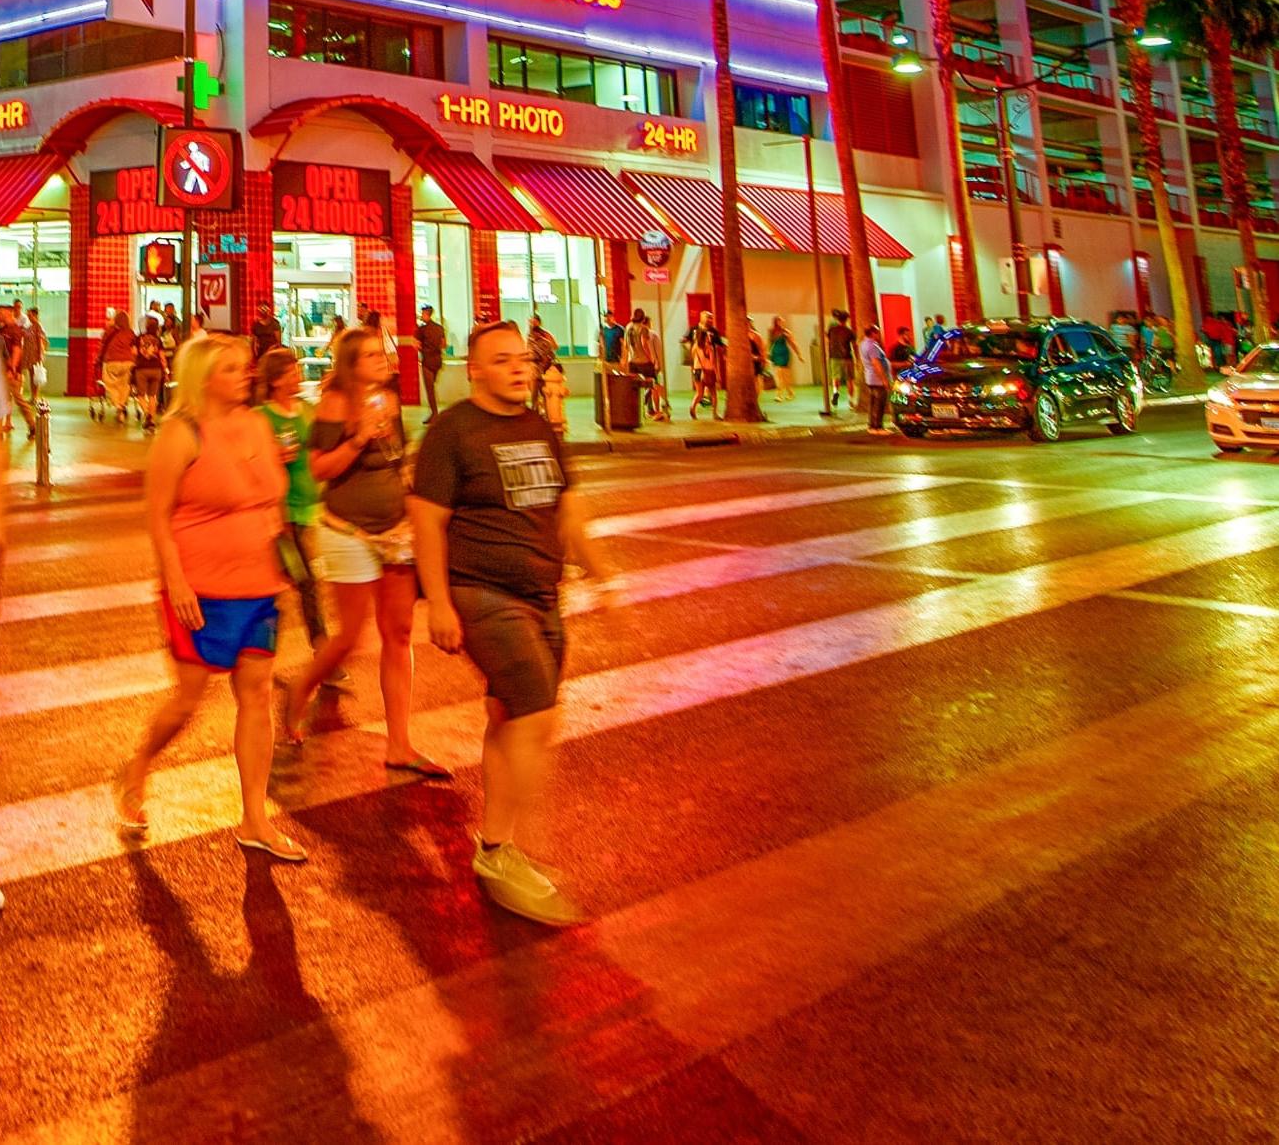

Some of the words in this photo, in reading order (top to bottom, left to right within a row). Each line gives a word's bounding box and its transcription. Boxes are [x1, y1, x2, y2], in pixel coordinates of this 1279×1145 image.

[438, 93, 491, 126] 1-HR
[498, 101, 565, 137] PHOTO
[642, 120, 698, 152] 24-HR
[116, 167, 157, 200] OPE
[305, 164, 360, 200] OPEN
[96, 200, 121, 234] 24
[281, 193, 312, 232] 24
[312, 198, 384, 236] HOURS
